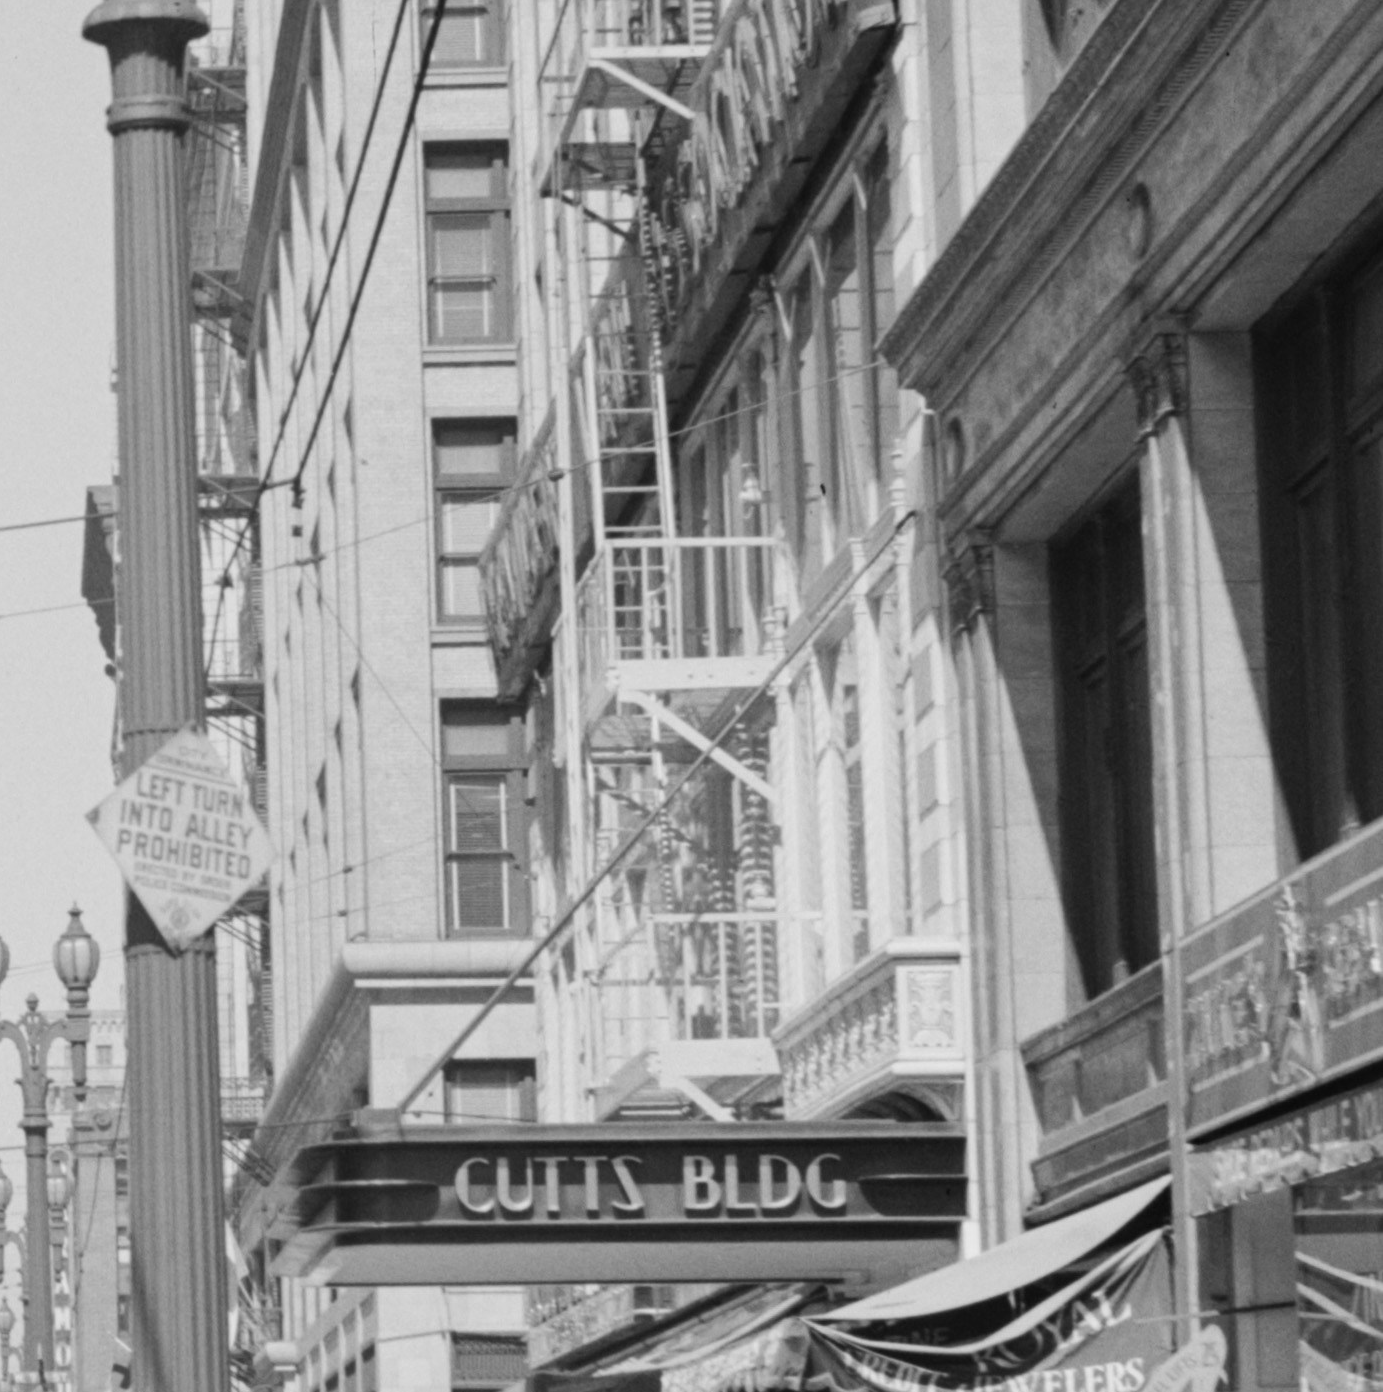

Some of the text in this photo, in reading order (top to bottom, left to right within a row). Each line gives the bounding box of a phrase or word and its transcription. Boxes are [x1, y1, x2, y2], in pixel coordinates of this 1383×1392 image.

[136, 772, 244, 819] LEFT TURN
[120, 799, 253, 849] INTO ALLEY
[117, 828, 250, 879] PROHIBITED
[454, 1154, 848, 1214] CUTTS BLDG
[971, 1289, 1133, 1373] ROYAL
